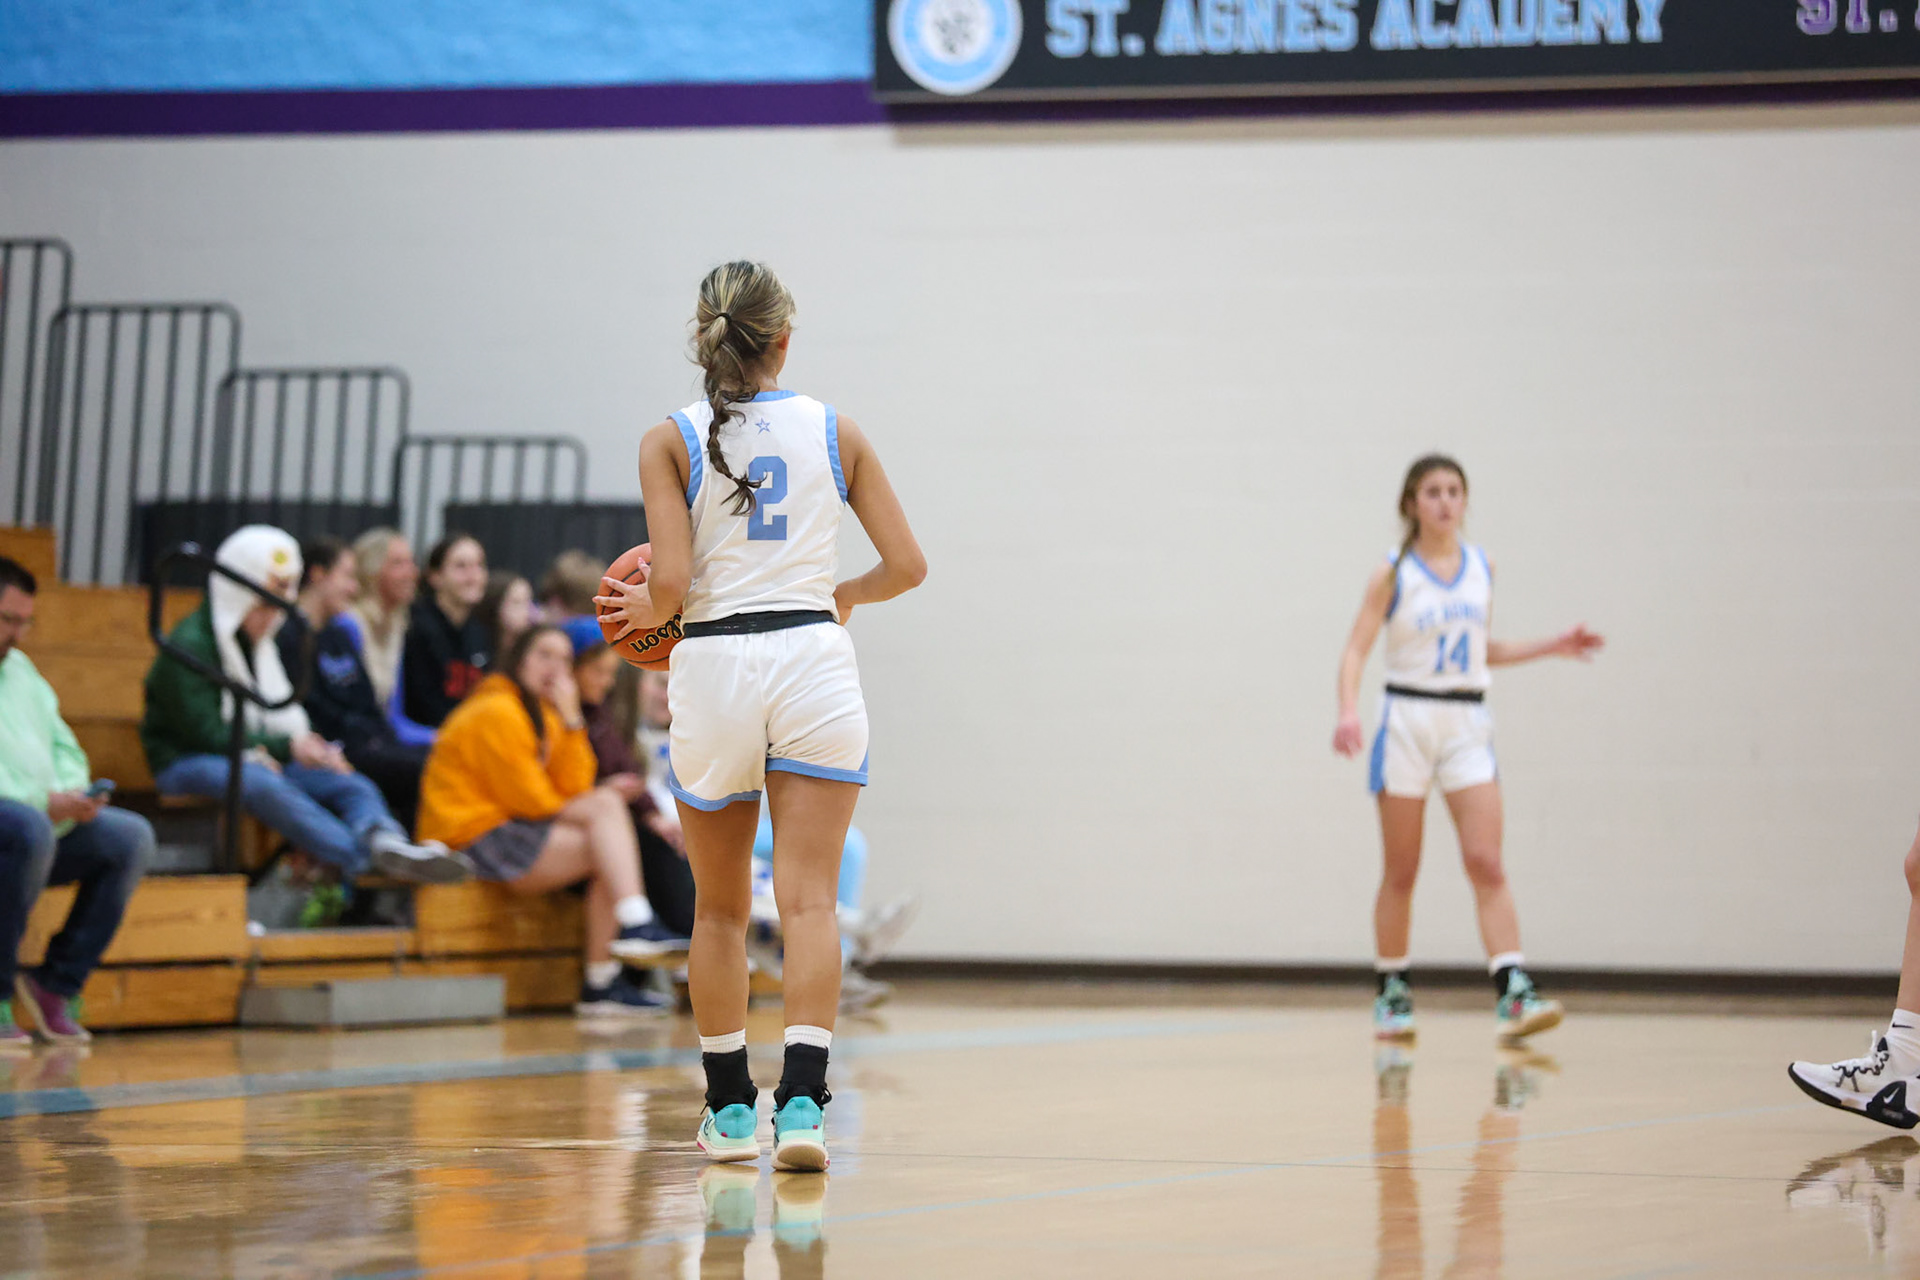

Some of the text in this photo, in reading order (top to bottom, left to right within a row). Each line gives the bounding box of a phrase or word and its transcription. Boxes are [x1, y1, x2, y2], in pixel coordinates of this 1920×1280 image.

[1045, 0, 1663, 57] ST. AGNES ACADEMY
[747, 456, 788, 540] 2
[1434, 631, 1470, 674] 14
